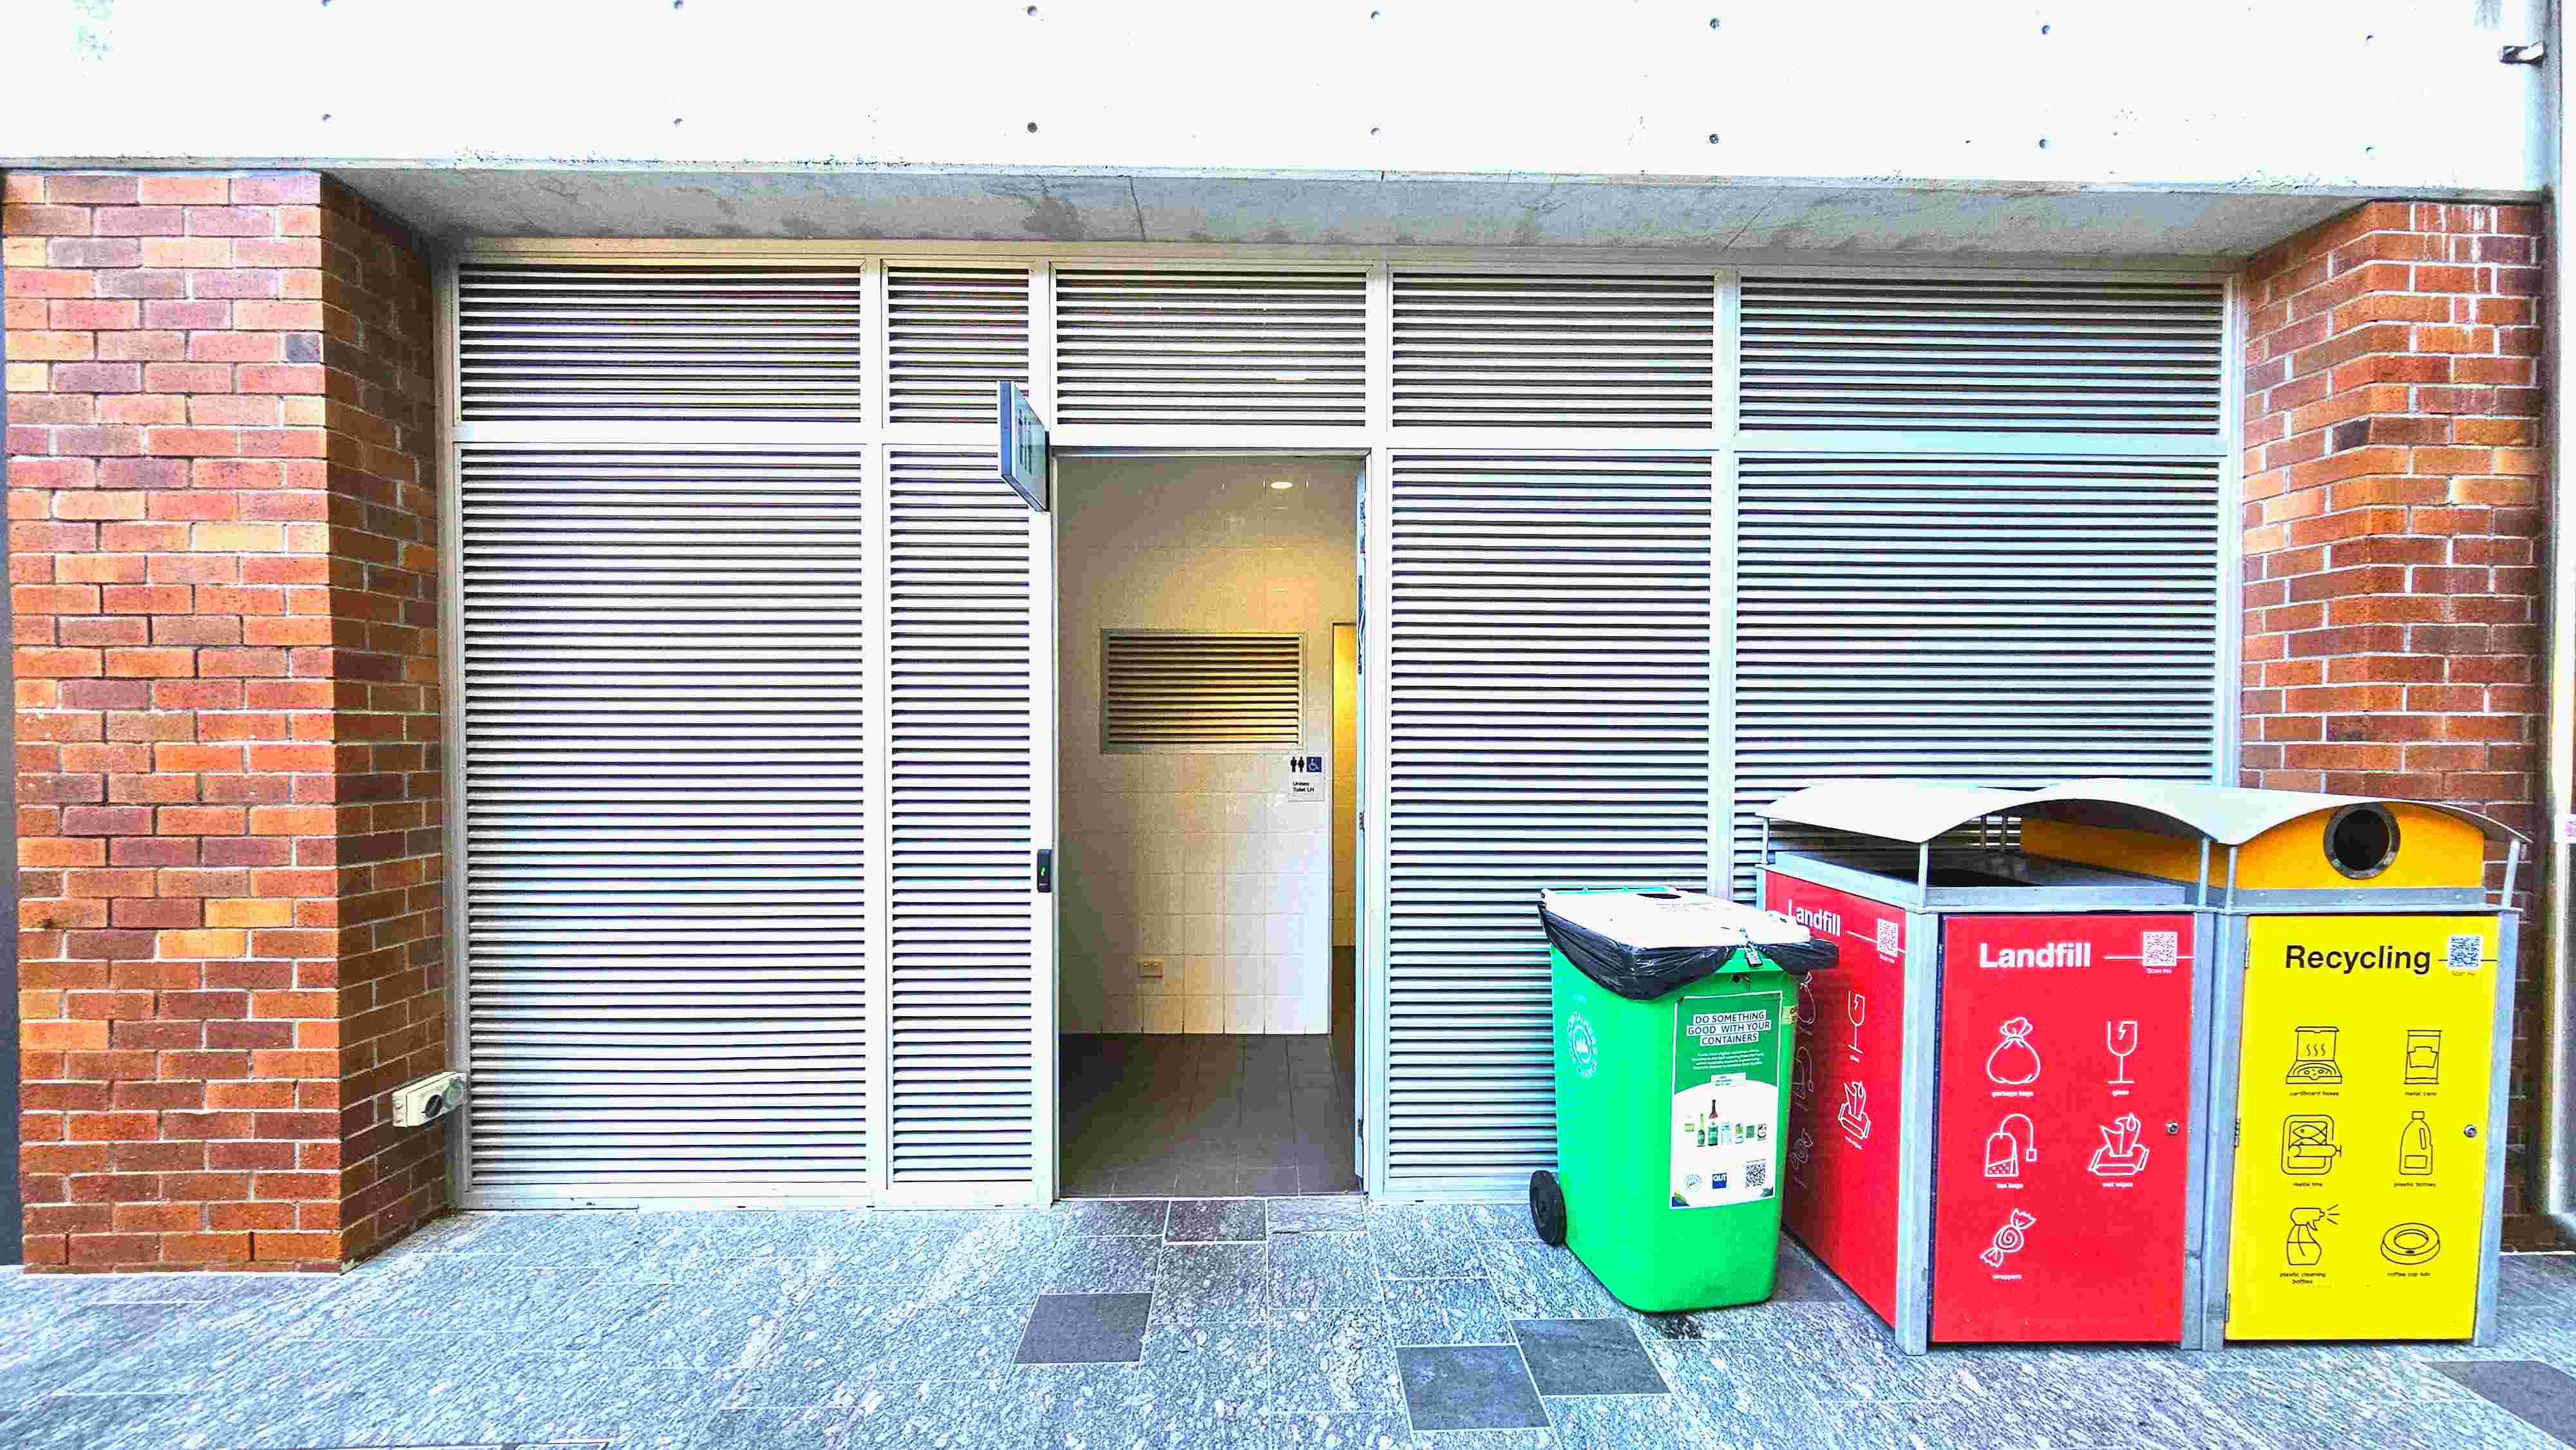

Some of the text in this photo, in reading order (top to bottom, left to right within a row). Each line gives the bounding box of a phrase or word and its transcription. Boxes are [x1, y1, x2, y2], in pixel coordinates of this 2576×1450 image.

[1979, 942, 2092, 968] Landfill
[2286, 945, 2431, 975] Recycling
[1695, 1011, 1765, 1024] DO SOMETHING
[1688, 1021, 1770, 1035] GOOD WITH YOUR
[1701, 1033, 1757, 1044] CONTAINERS
[1714, 1174, 1727, 1182] QUT
